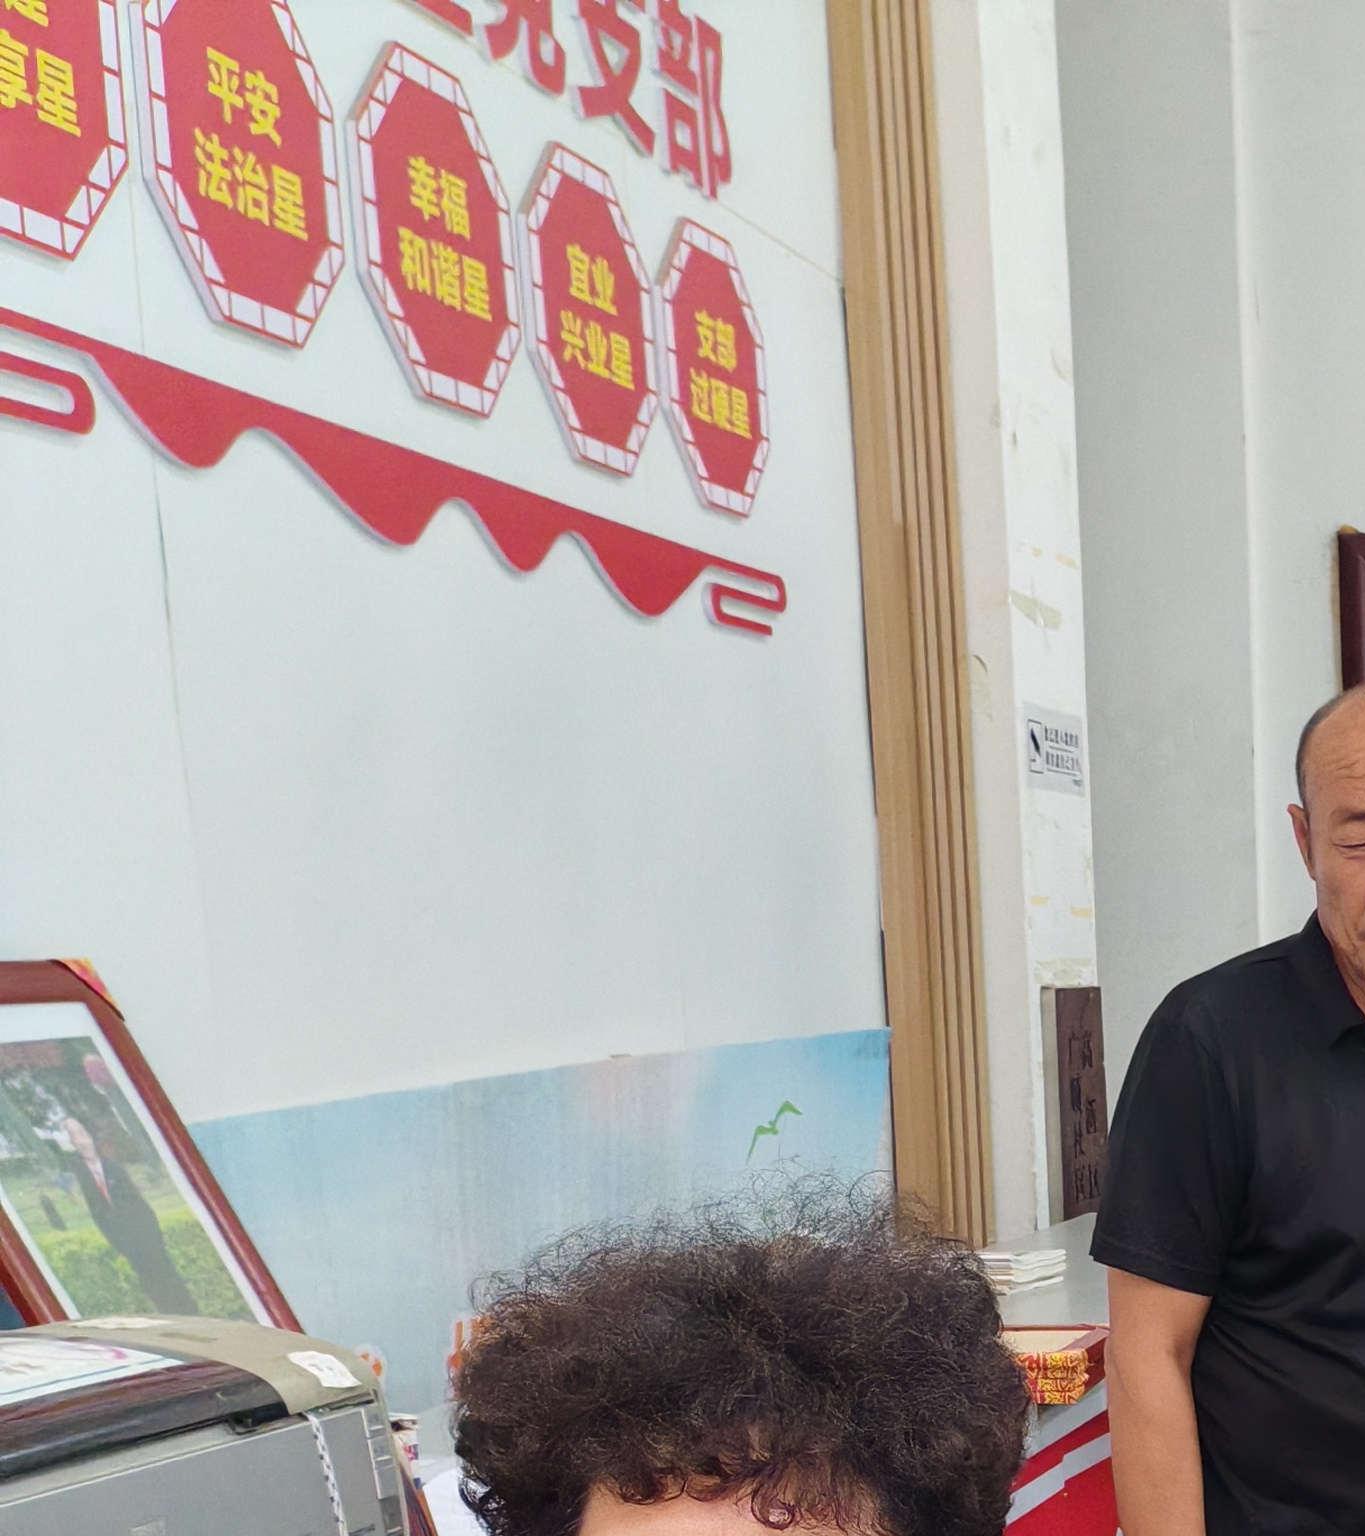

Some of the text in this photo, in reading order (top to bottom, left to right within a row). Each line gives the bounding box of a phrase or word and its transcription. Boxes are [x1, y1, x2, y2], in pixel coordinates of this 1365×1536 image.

[206, 46, 283, 149] 平安
[193, 126, 309, 242] 法治星
[407, 156, 471, 241] 幸福
[397, 226, 493, 322] 和谐星
[560, 309, 636, 391] 兴业星
